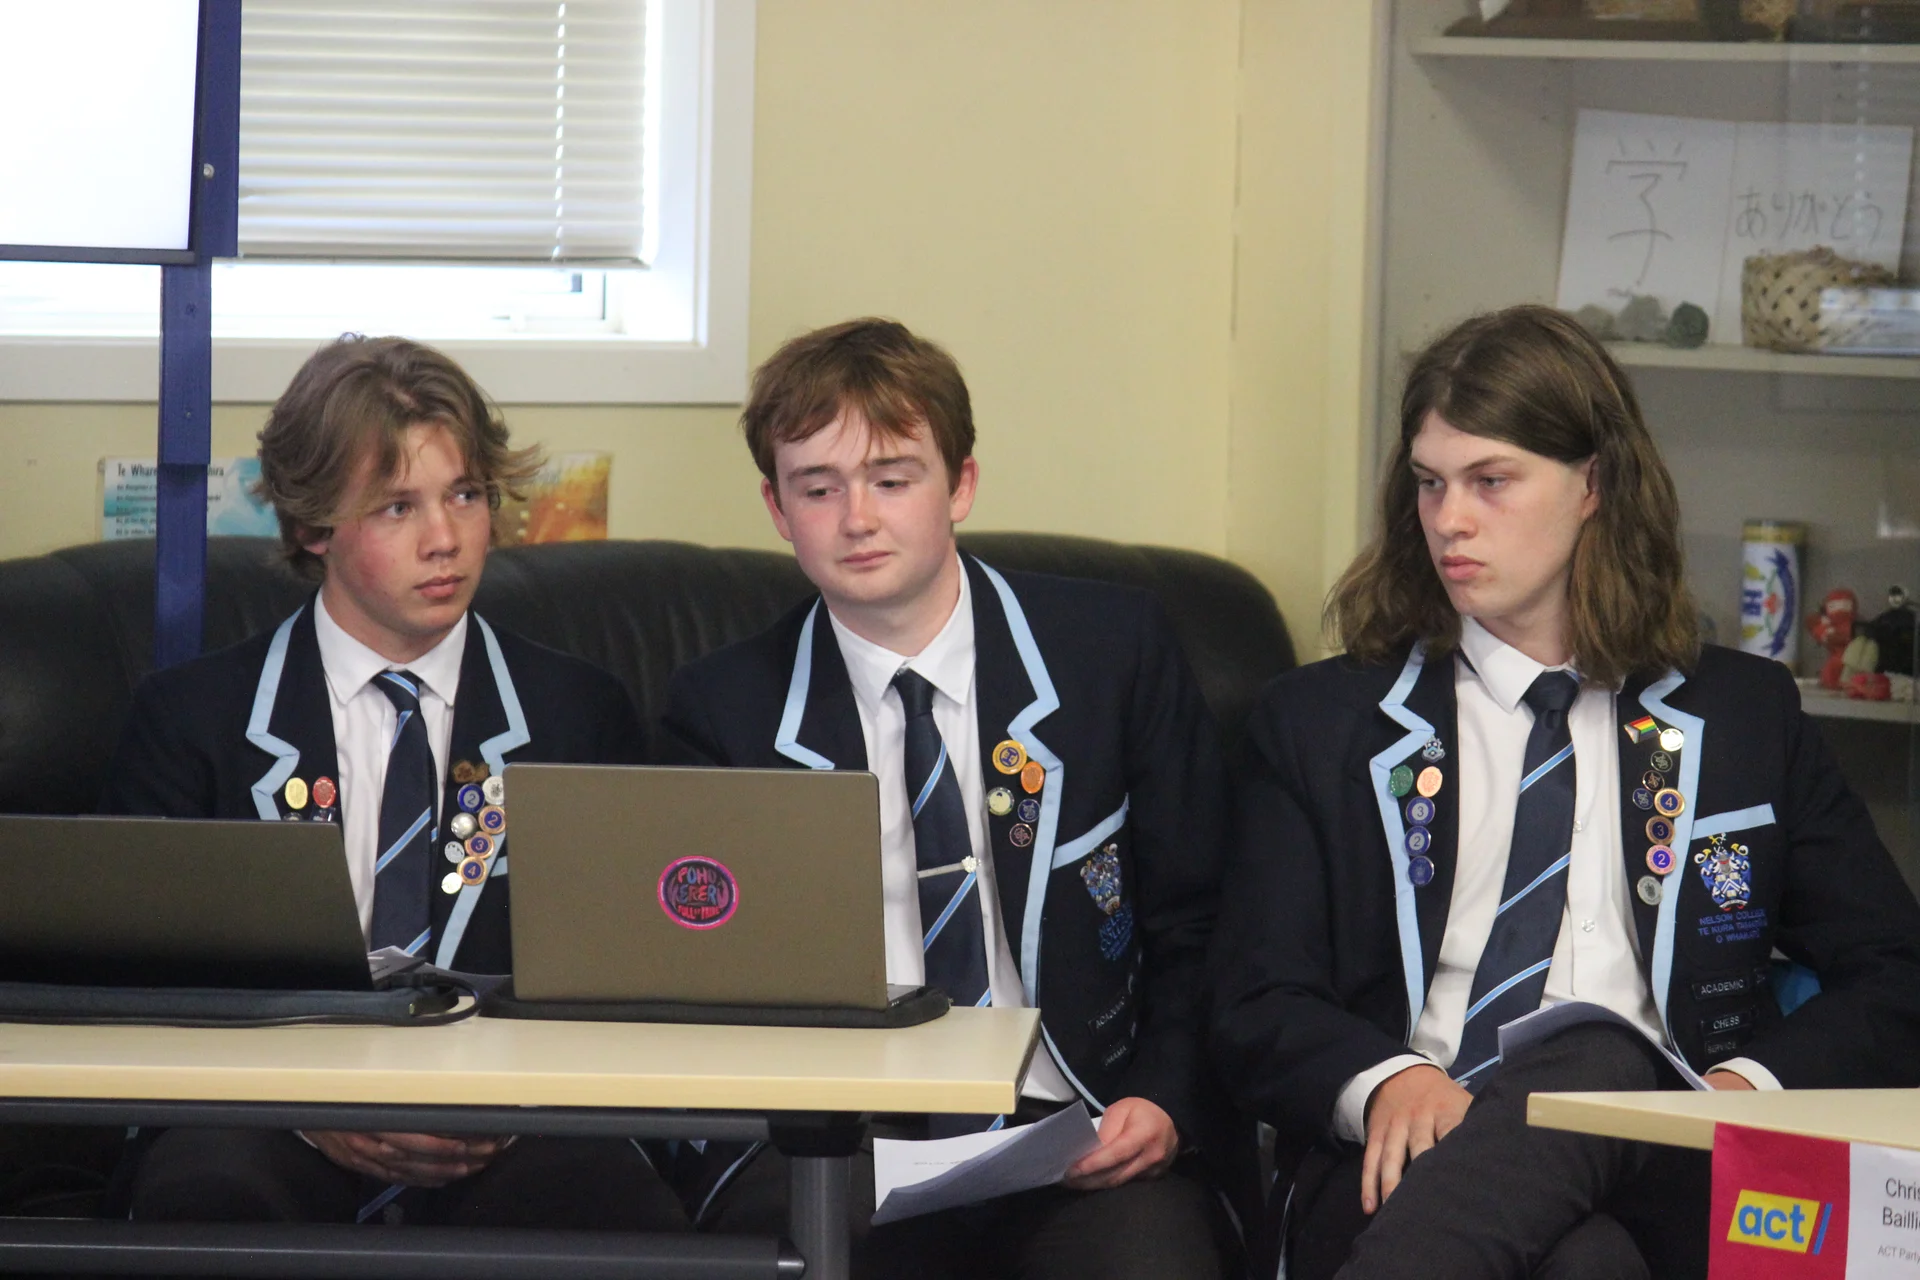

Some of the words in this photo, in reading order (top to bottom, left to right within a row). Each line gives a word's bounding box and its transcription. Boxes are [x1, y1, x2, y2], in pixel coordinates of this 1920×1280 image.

[1605, 138, 1688, 287] 学
[1735, 187, 1884, 246] ありがとう
[467, 793, 477, 806] 2
[1665, 796, 1673, 808] 4
[1417, 805, 1424, 818] 3
[487, 814, 499, 827] 2
[1657, 824, 1665, 837] 3
[475, 840, 485, 851] 3
[1413, 835, 1421, 847] 2
[1657, 853, 1666, 866] 2
[467, 865, 477, 877] 4
[1699, 913, 1733, 926] NELSON
[1701, 979, 1744, 995] ACADEMIC
[1713, 1015, 1740, 1029] CHESS
[1738, 1204, 1806, 1244] act
[1882, 1206, 1920, 1231] Bailli
[1877, 1245, 1896, 1257] ACT
